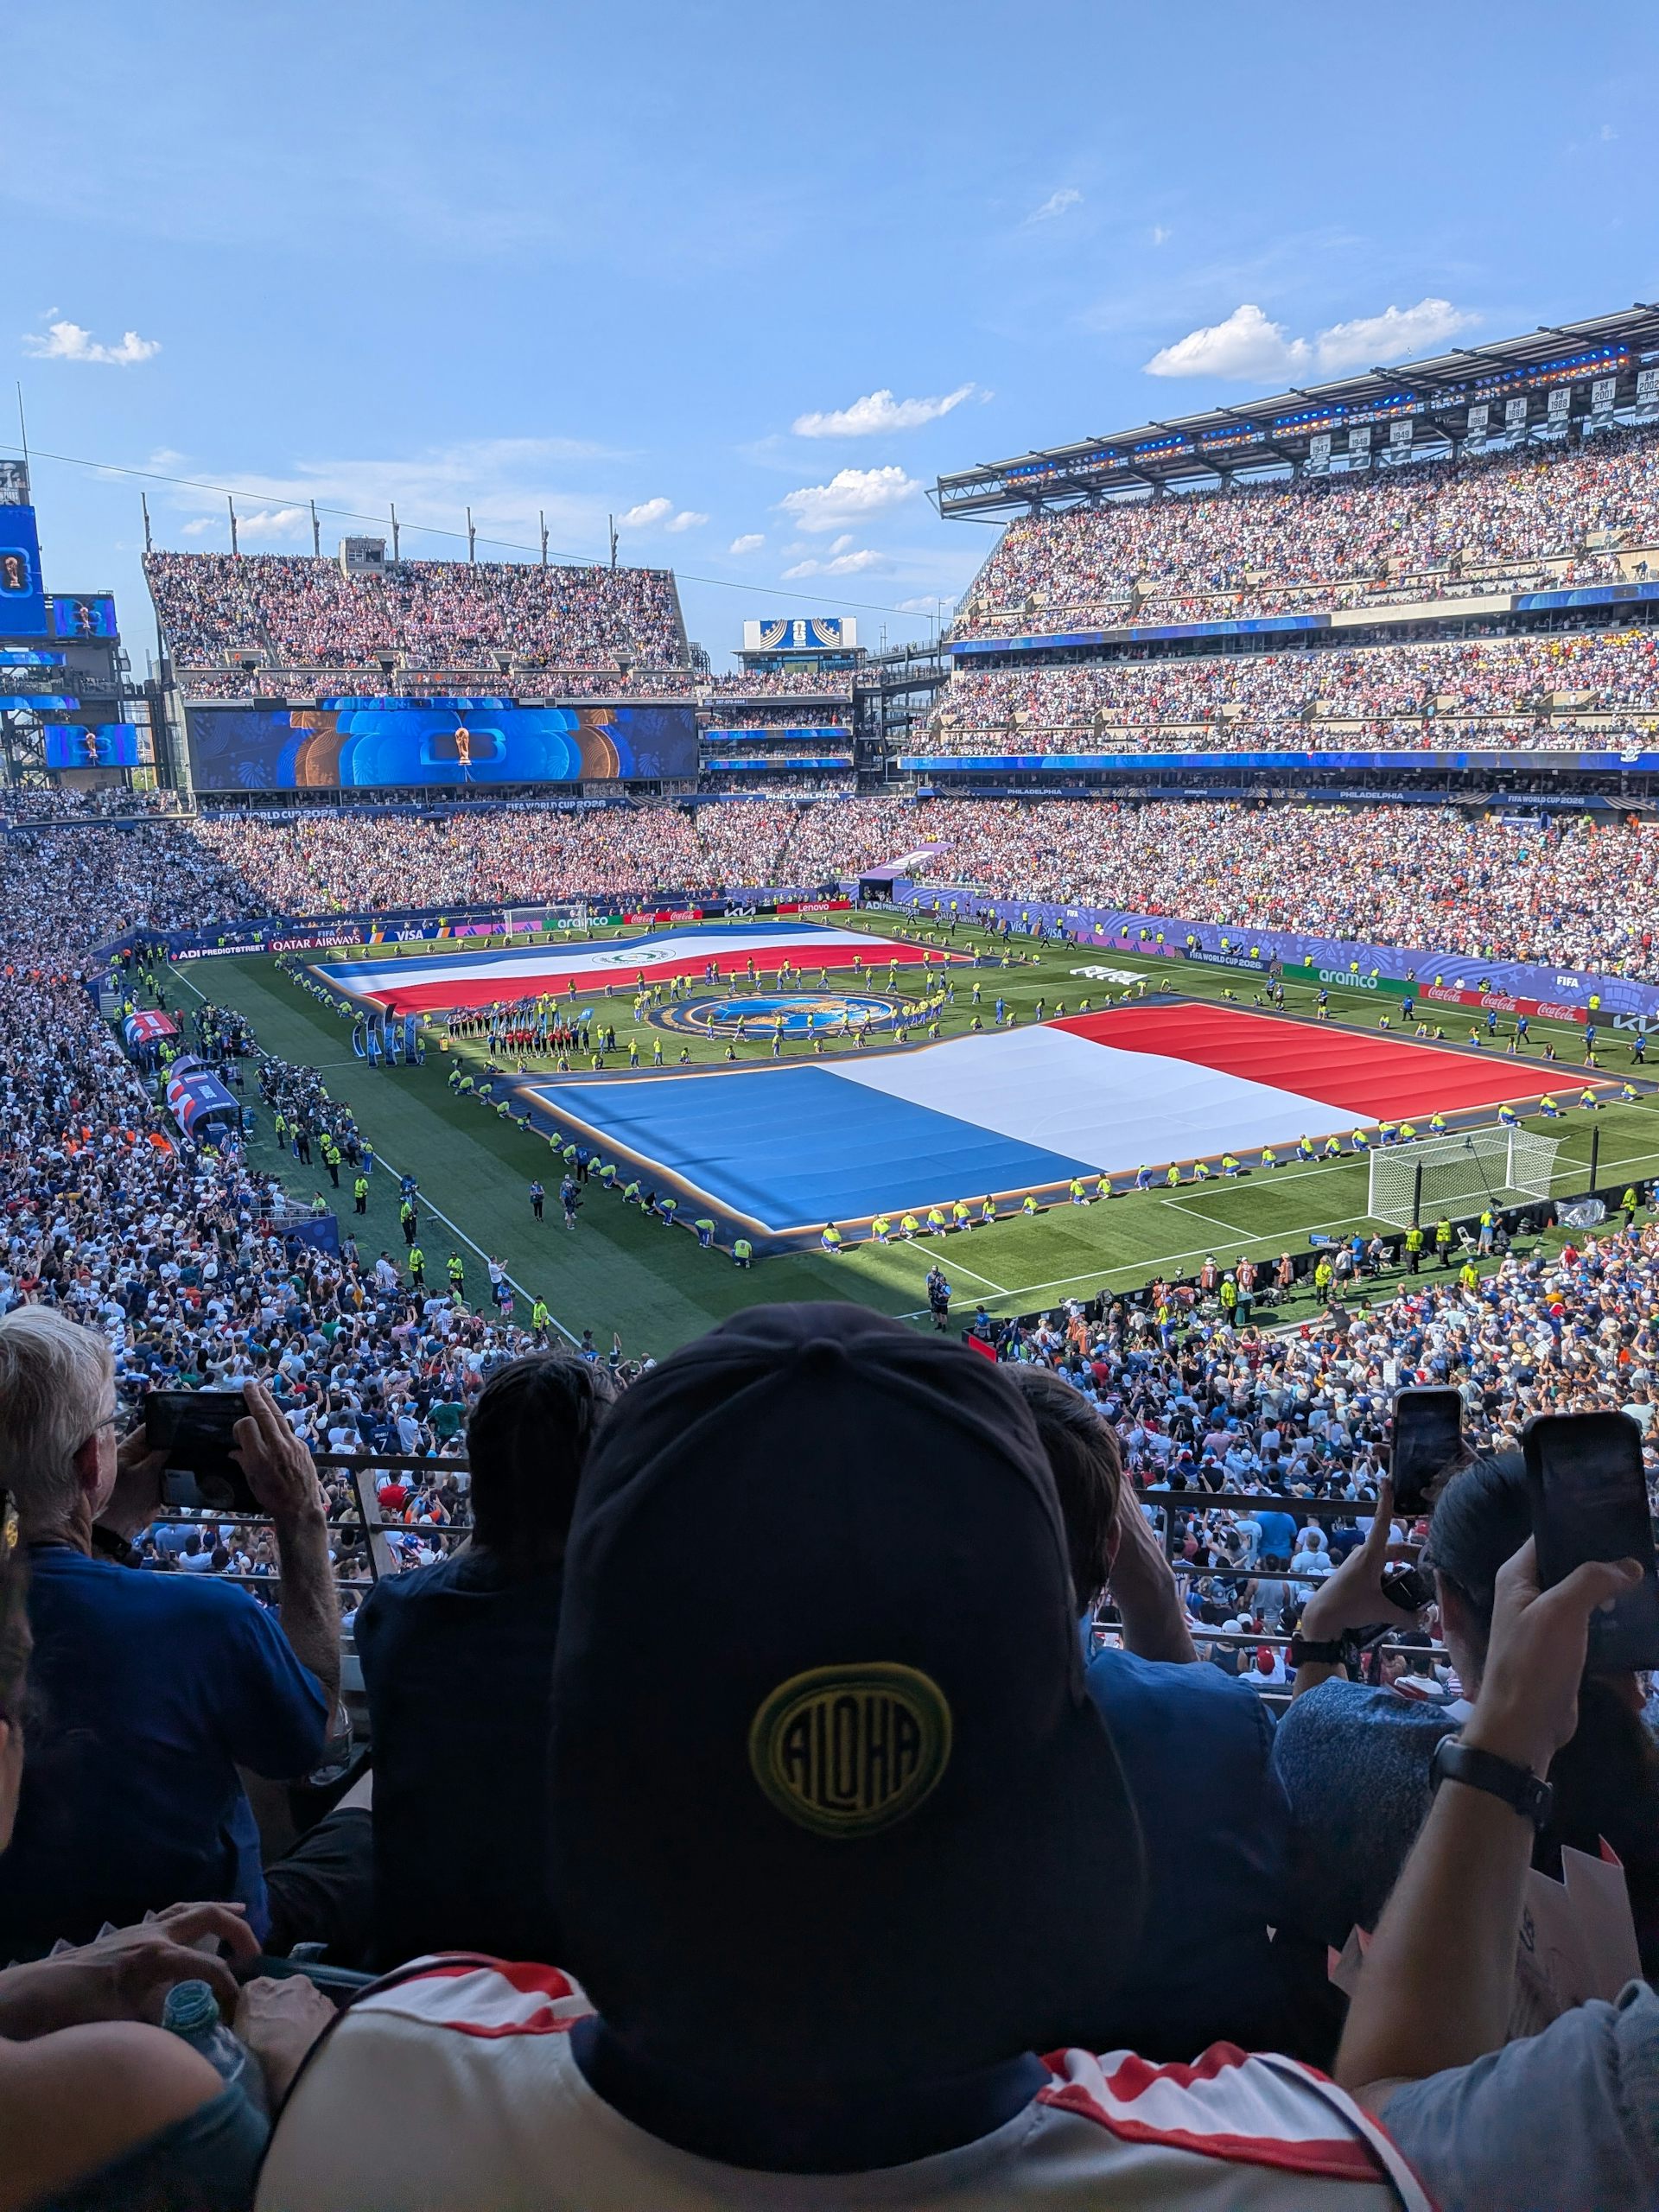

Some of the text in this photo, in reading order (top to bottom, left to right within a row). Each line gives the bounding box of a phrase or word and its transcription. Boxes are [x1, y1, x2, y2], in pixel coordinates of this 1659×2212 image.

[1639, 380, 1659, 391] 2002
[1595, 389, 1612, 401] 2001
[1551, 398, 1567, 410] 1988
[1509, 408, 1524, 418] 1980
[1471, 416, 1485, 426] 1960
[1394, 430, 1409, 441] 1949
[1313, 444, 1328, 454] 1947
[1340, 791, 1404, 800] PHILADELPHIA
[576, 800, 606, 809] 2026
[302, 809, 338, 818] 2026
[798, 902, 830, 912] Lenovo
[866, 901, 882, 911] ADI
[671, 911, 695, 921] Coca-Cola
[724, 907, 757, 917] KIA
[557, 915, 607, 929] aramco
[958, 914, 982, 925] AIRWAYS
[1010, 921, 1027, 933] VISA
[394, 929, 424, 941] VISA
[273, 935, 361, 951] QATAR AIRWAYS
[179, 949, 200, 960] ADI
[1189, 951, 1261, 969] FIFA WORLD CUP 2026
[1319, 969, 1378, 989] aramco
[1557, 976, 1580, 988] FIFA
[379, 1438, 387, 1452] 7
[784, 1696, 921, 1810] ALOHA
